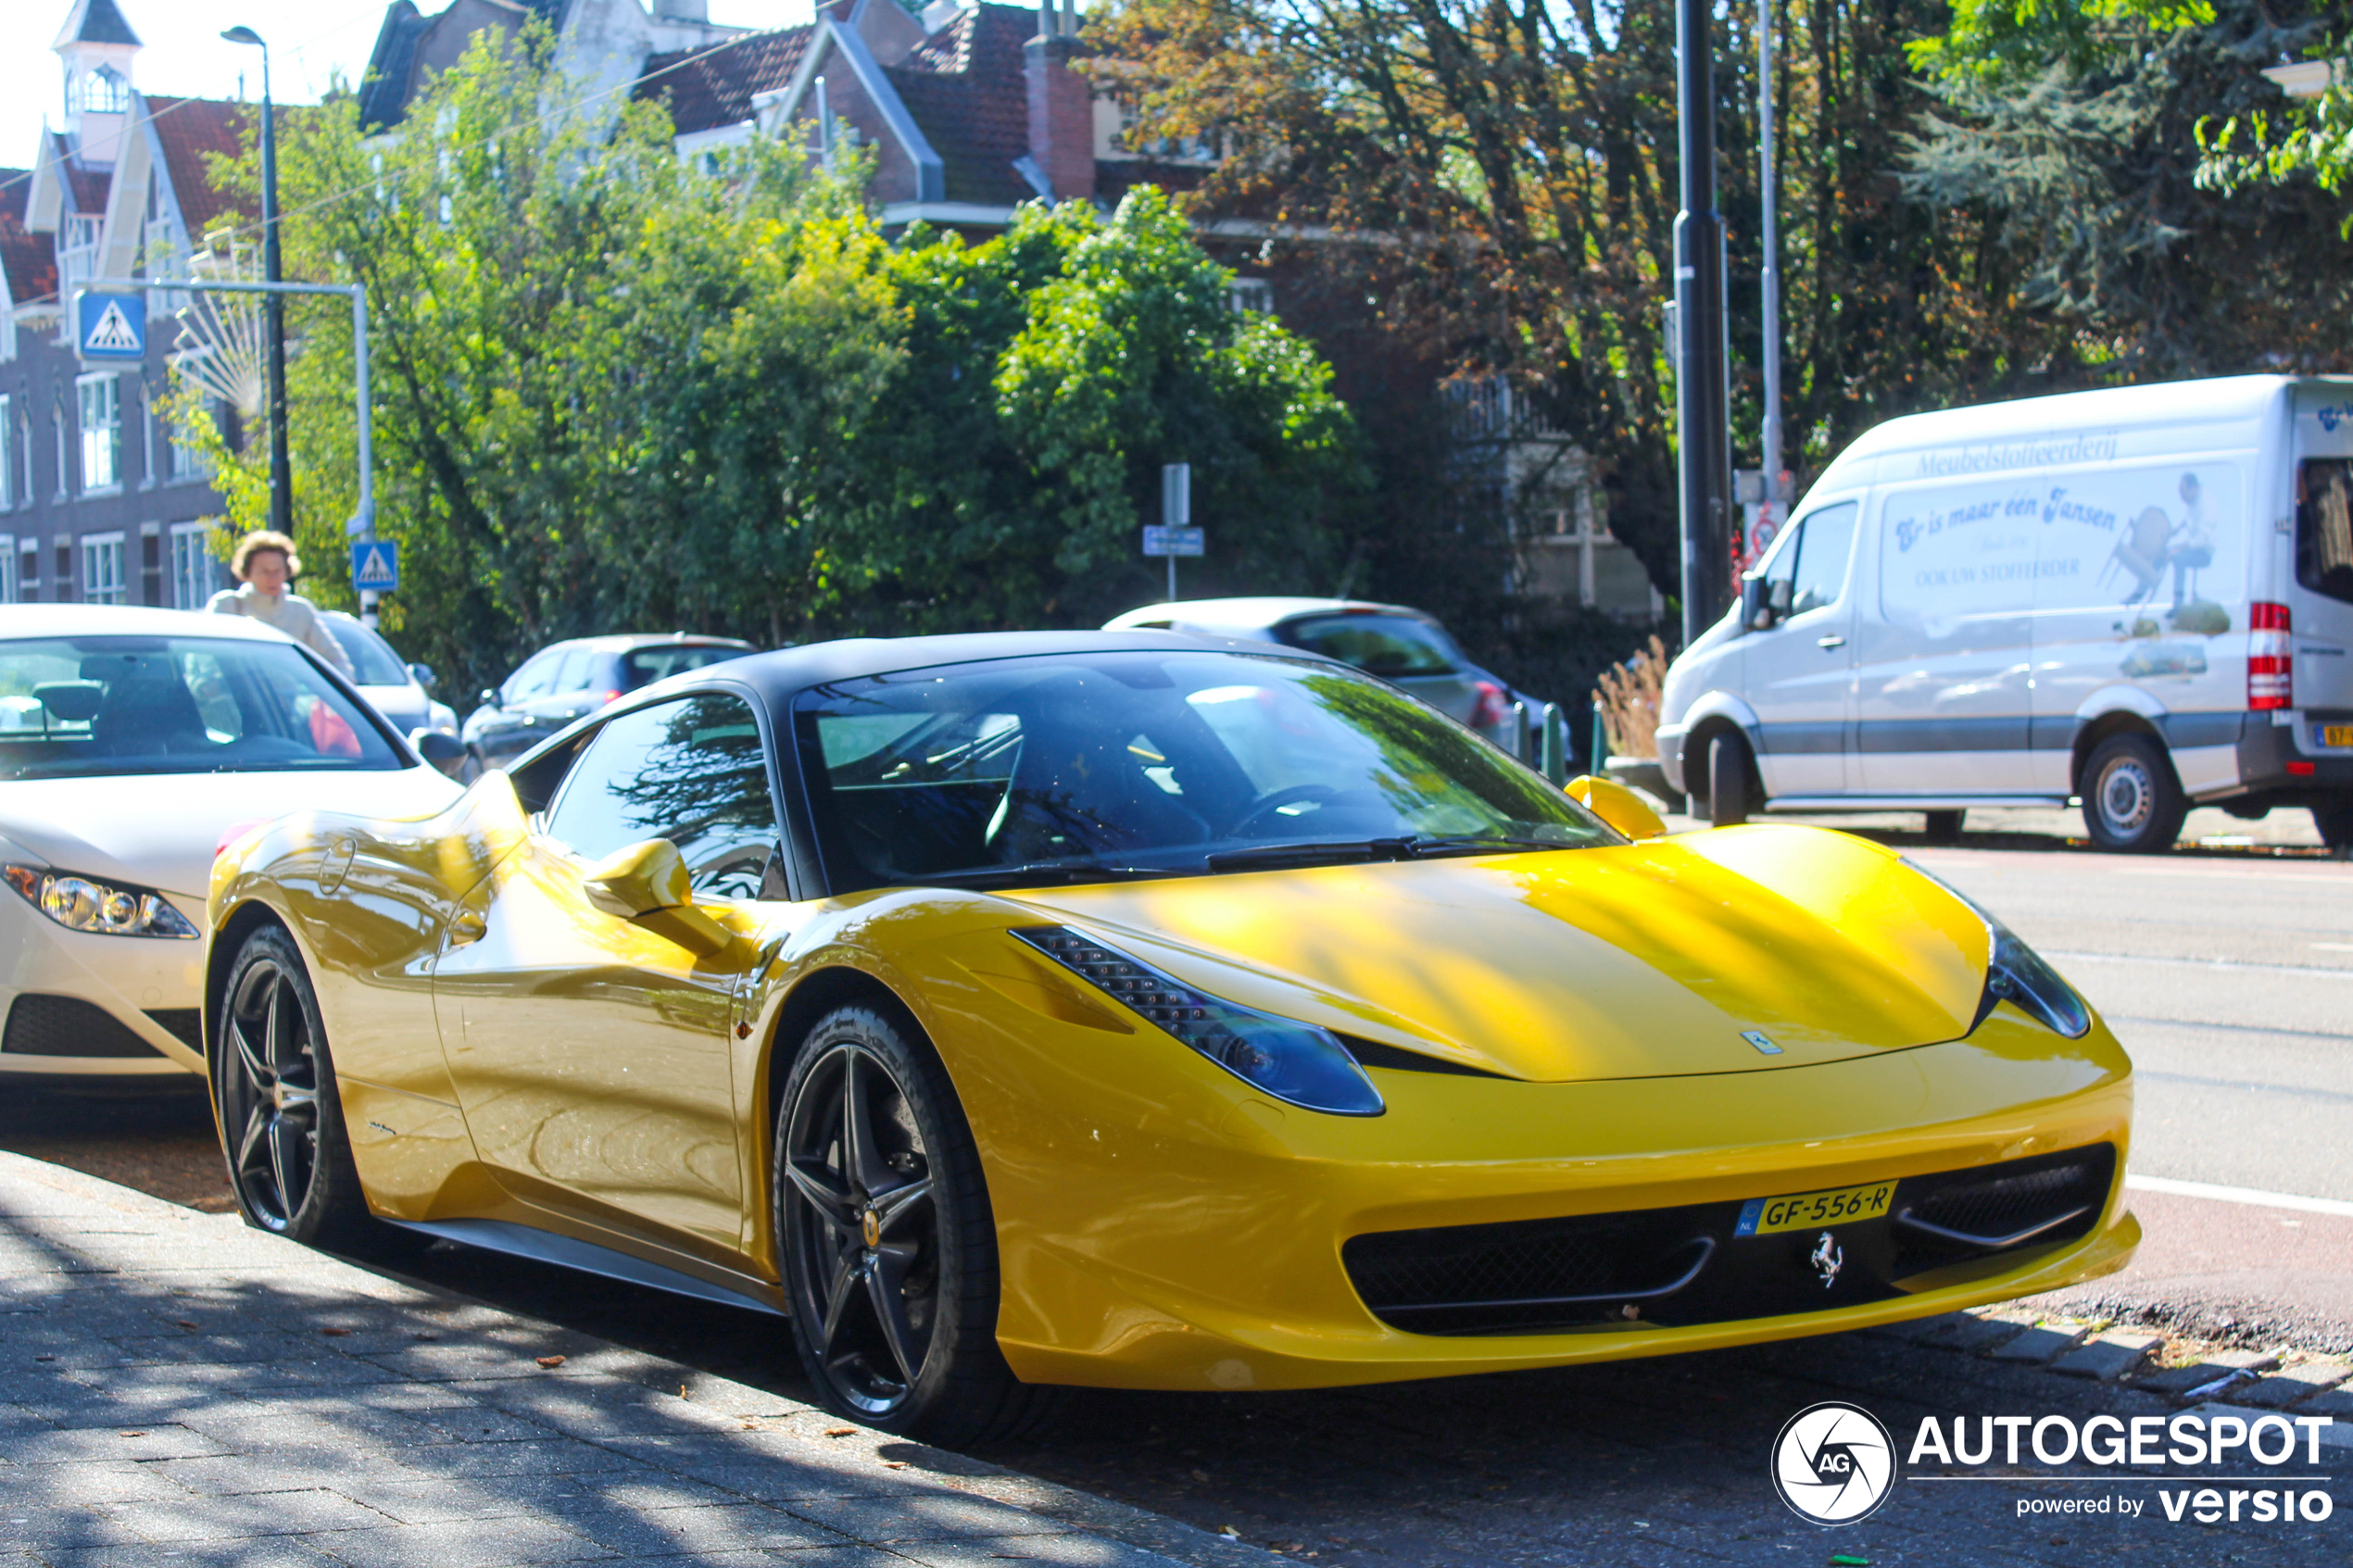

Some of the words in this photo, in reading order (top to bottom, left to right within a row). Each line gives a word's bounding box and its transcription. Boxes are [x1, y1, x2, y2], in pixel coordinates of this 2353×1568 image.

[1929, 510, 1943, 535] is
[1949, 500, 2001, 529] maar
[2043, 485, 2117, 532] Jansen
[1767, 1186, 1889, 1226] GF-556-R
[1740, 1223, 1752, 1231] NL
